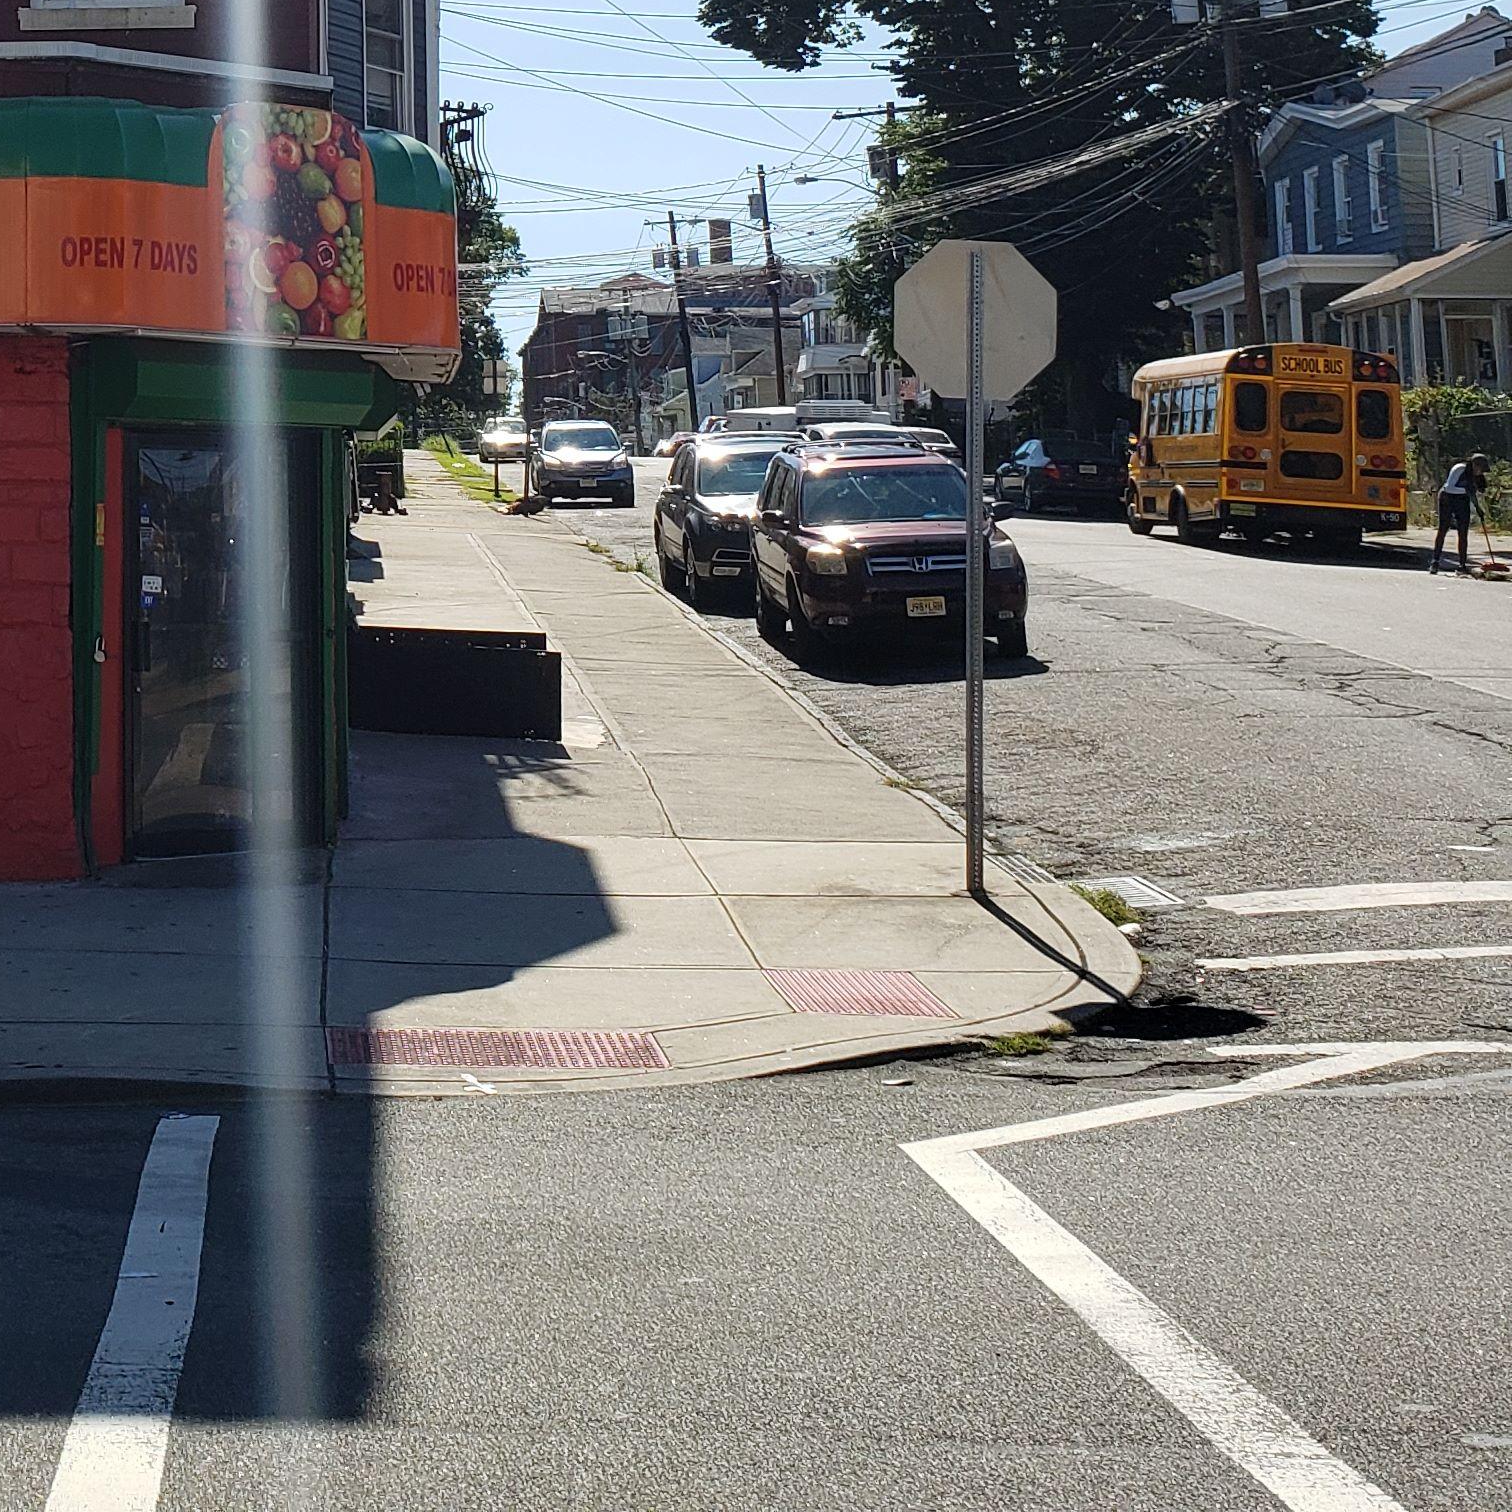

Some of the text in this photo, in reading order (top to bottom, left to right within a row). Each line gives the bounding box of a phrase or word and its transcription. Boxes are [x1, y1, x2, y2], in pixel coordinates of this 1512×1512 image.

[61, 236, 198, 275] OPEN 7 DAYS
[393, 263, 435, 295] OPEN
[438, 266, 446, 296] 7
[1281, 356, 1343, 375] SCHOOL BUS
